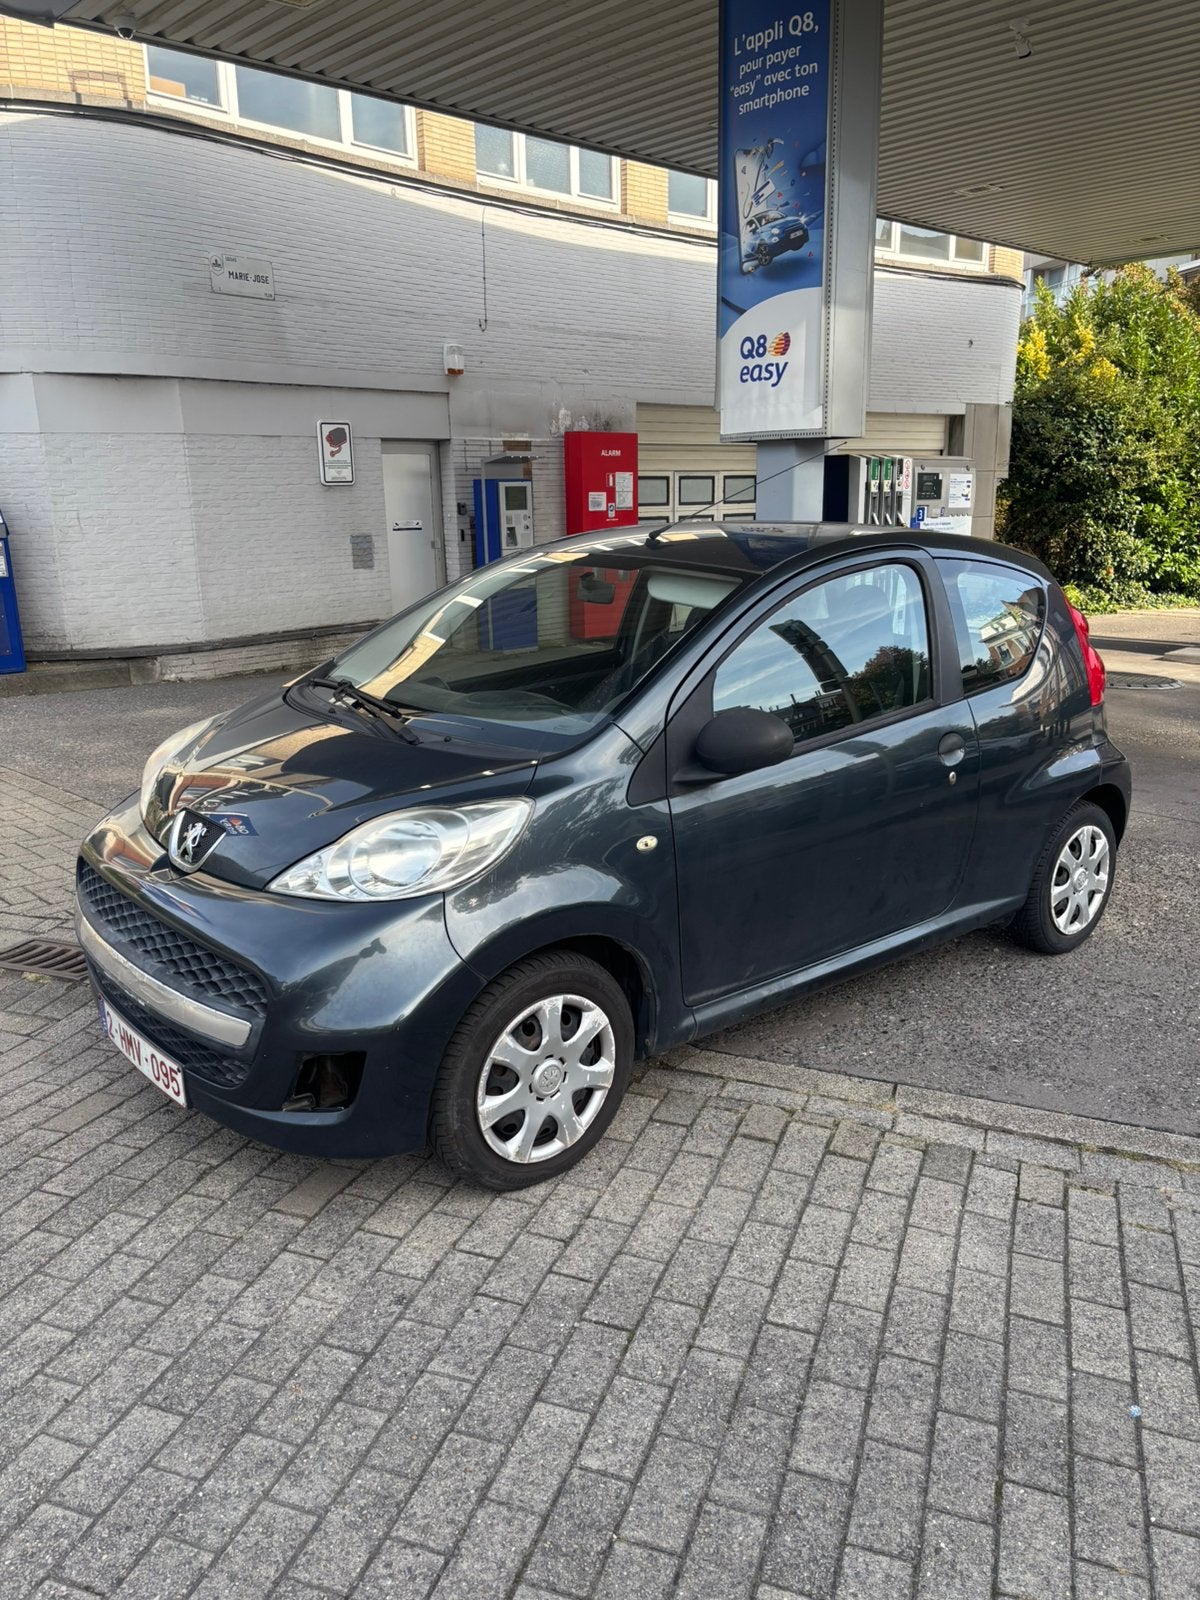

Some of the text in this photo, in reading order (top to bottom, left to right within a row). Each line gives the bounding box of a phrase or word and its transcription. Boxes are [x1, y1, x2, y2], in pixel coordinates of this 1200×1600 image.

[734, 11, 819, 56] L'appli Q8,
[739, 45, 802, 79] pour payer
[764, 68, 792, 86] avec
[795, 62, 818, 77] ton
[738, 85, 810, 115] smartphone
[740, 334, 767, 360] Q8
[740, 361, 788, 388] easy
[601, 449, 621, 457] ALARM
